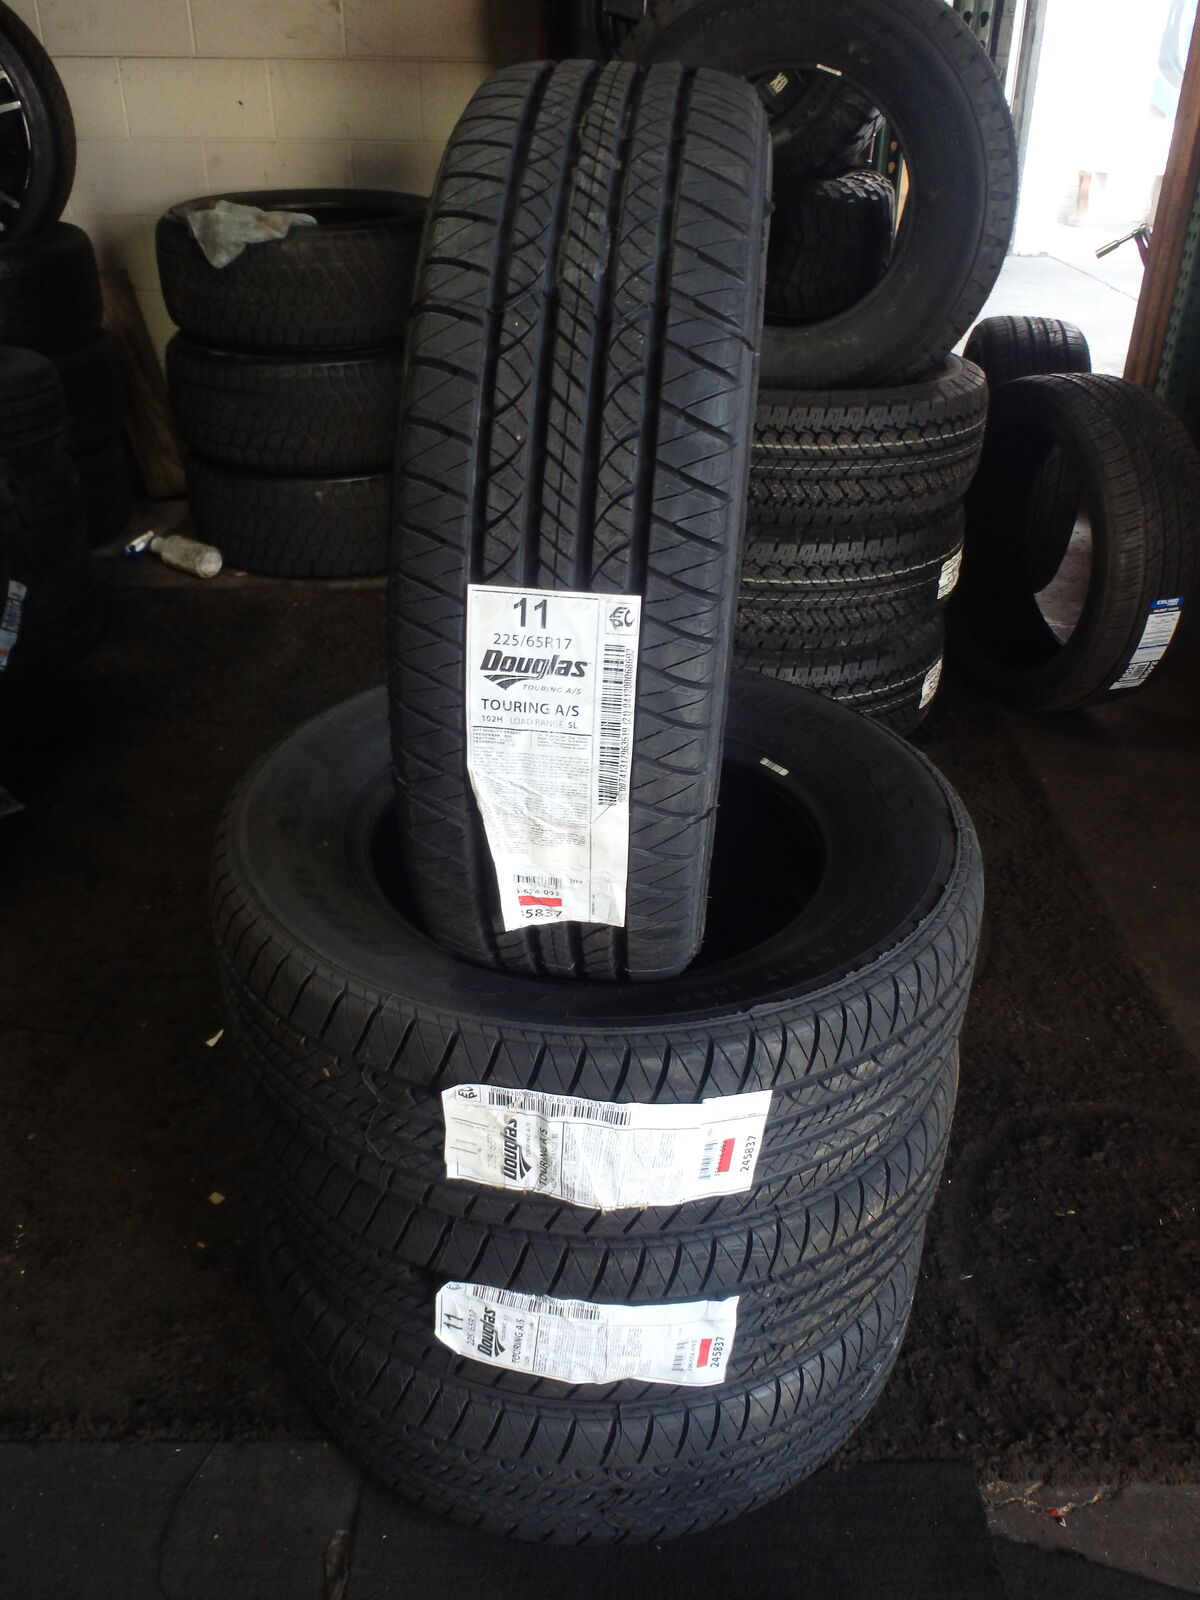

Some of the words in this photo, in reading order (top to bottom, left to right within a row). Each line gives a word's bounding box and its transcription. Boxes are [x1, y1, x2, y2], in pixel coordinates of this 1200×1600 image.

[513, 597, 548, 629] 11
[493, 632, 573, 650] 225/65R17
[479, 649, 589, 680] Douglas
[522, 683, 563, 694] TOURING
[481, 698, 551, 715] TOURING
[555, 704, 580, 717] A/S
[481, 714, 503, 723] 102H
[509, 715, 534, 726] LOAD
[567, 721, 579, 730] SL
[539, 1146, 548, 1186] TOURING
[739, 1135, 757, 1173] 245837
[443, 1312, 464, 1331] 11
[477, 1306, 497, 1358] Douglas
[511, 1333, 522, 1365] TOURING
[710, 1336, 725, 1368] 245837
